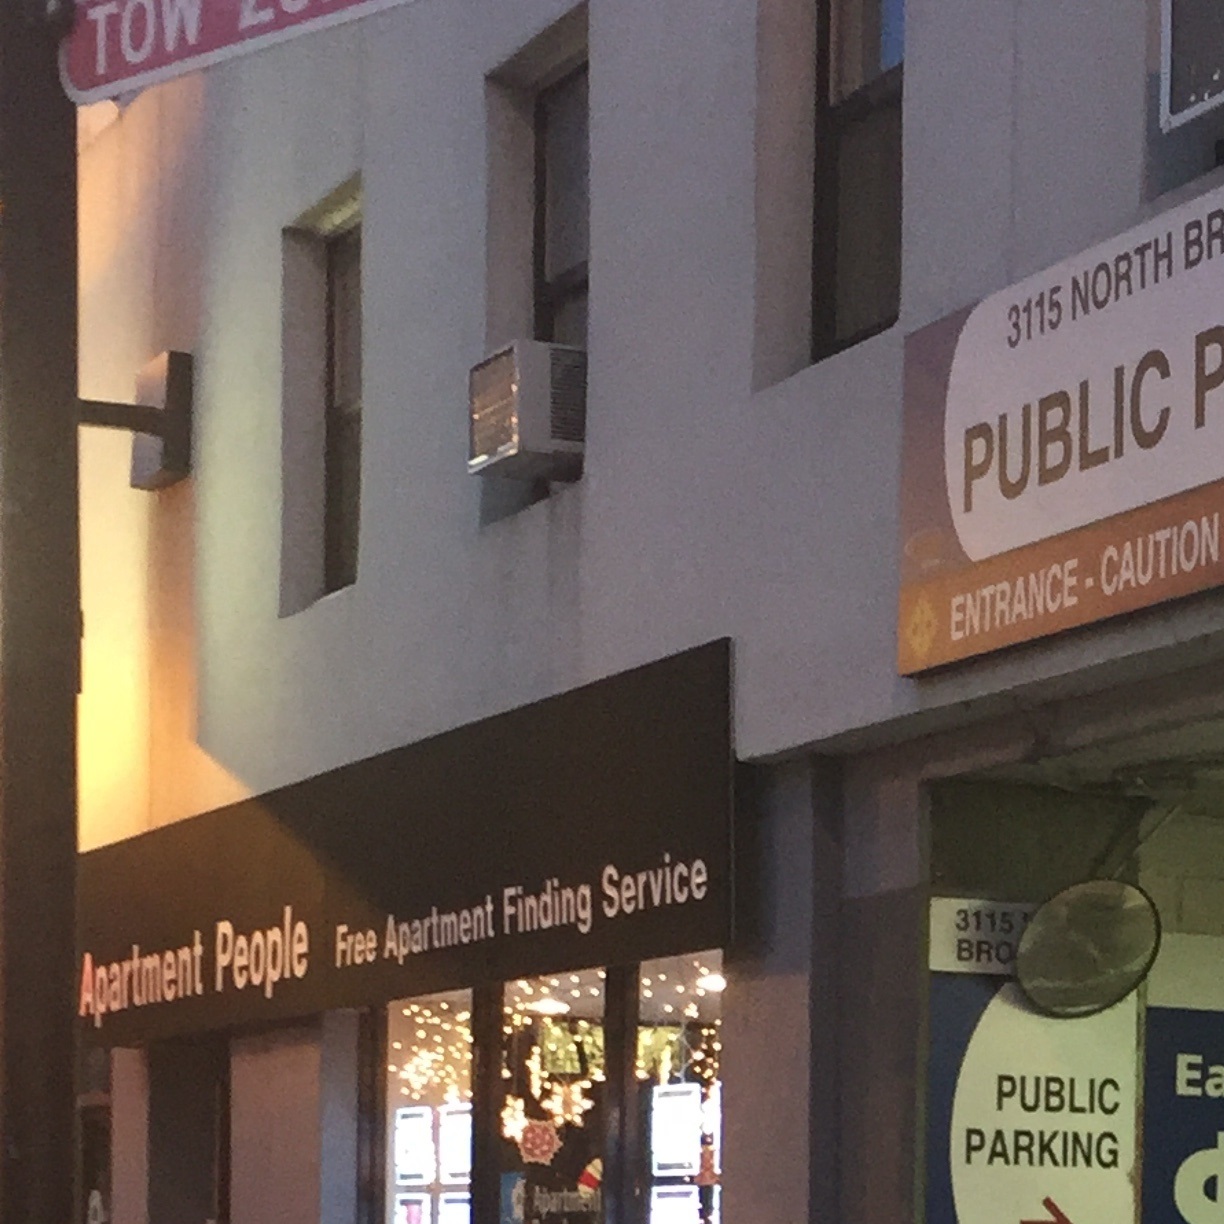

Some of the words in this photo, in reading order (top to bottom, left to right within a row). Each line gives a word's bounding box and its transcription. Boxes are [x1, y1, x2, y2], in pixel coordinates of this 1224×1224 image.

[87, 0, 202, 75] TOW
[1007, 286, 1063, 348] 3115
[1071, 233, 1174, 321] NORTH
[963, 350, 1171, 513] PUBLIC
[950, 558, 1078, 641] ENTRANCE
[1100, 514, 1219, 595] CAUTION
[79, 929, 204, 1027] Apartment
[216, 906, 310, 998] People
[335, 924, 378, 969] Free
[384, 895, 496, 965] Apartment
[503, 877, 592, 934] Finding
[602, 853, 709, 918] Service
[956, 908, 1014, 934] 3115
[996, 1075, 1120, 1115] PUBLIC
[965, 1128, 1120, 1169] PARKING
